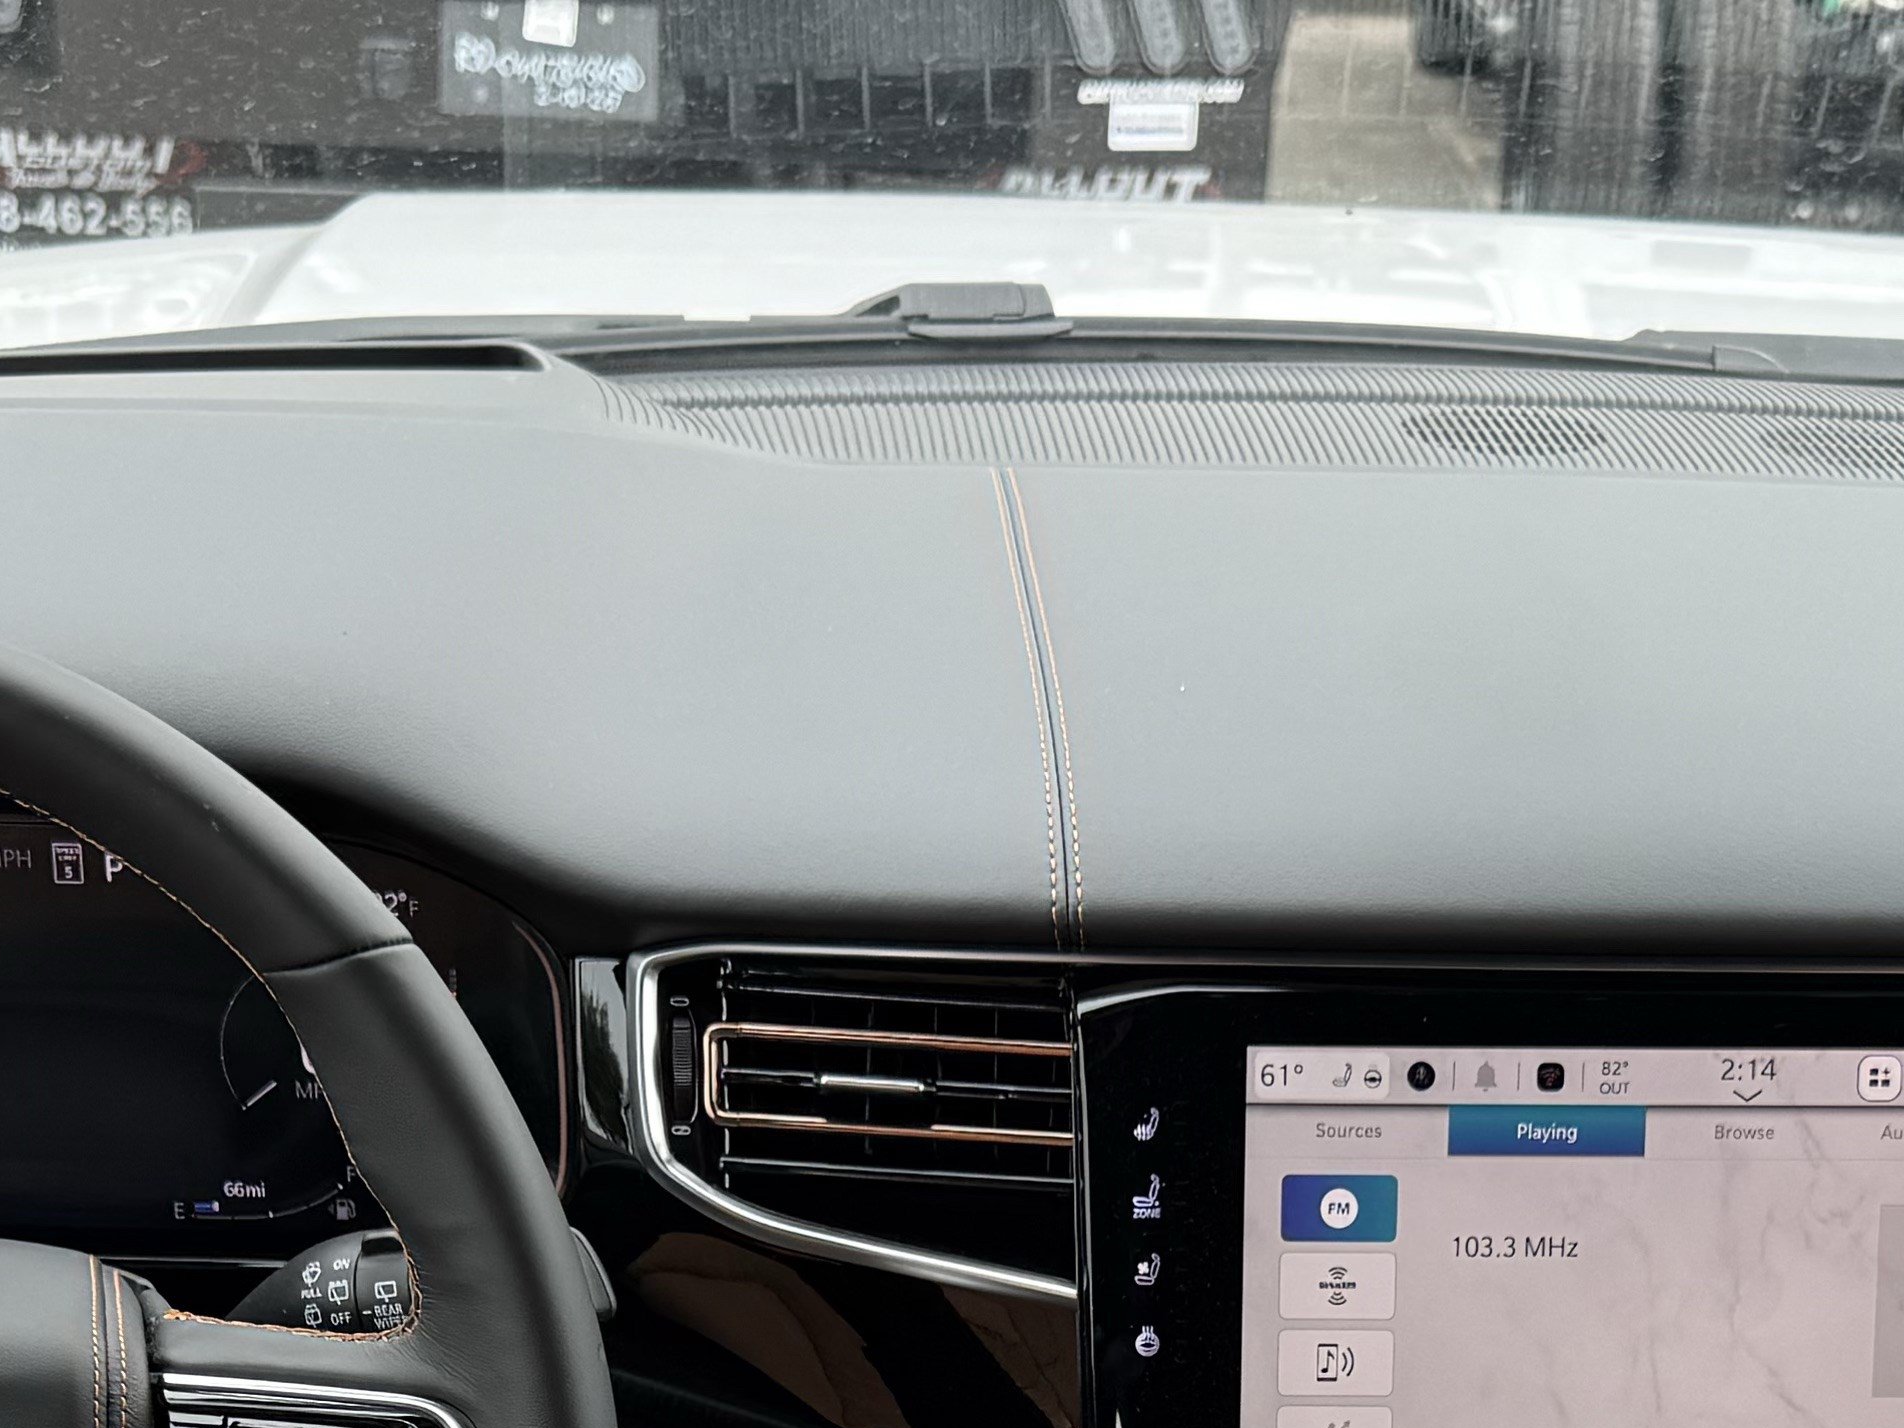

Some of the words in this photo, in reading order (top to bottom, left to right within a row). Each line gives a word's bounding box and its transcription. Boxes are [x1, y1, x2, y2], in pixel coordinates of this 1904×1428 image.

[1259, 1062, 1305, 1088] 61°
[1600, 1060, 1630, 1077] 82°
[1719, 1058, 1778, 1083] 2:14
[1599, 1081, 1630, 1096] OUT
[1314, 1122, 1384, 1140] Sources
[1516, 1122, 1579, 1145] Playing
[1713, 1124, 1776, 1141] Browse
[173, 1202, 186, 1220] E
[1327, 1201, 1352, 1216] FM
[1451, 1236, 1517, 1259] 103.3
[1523, 1236, 1580, 1260] MHz
[333, 1258, 352, 1271] ON
[330, 1310, 353, 1326] OFF
